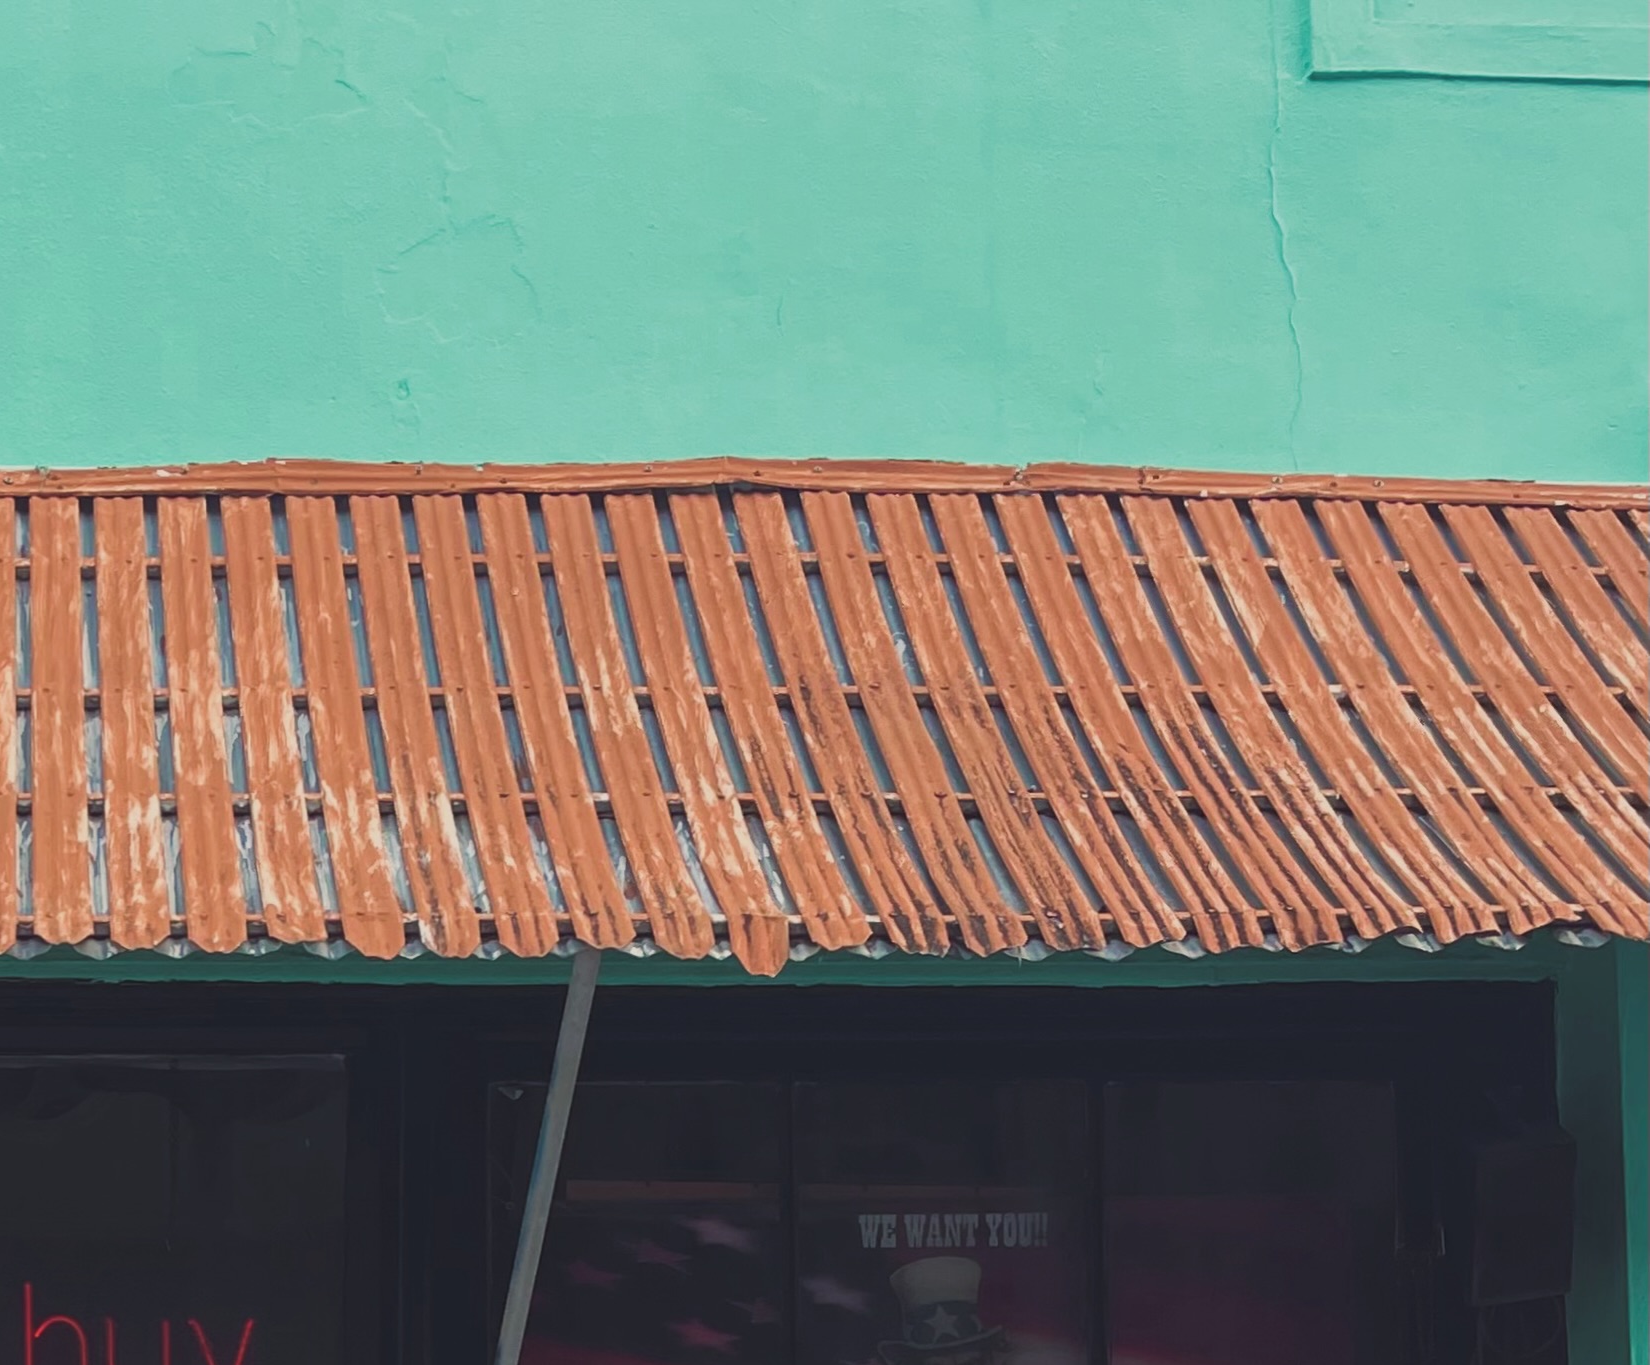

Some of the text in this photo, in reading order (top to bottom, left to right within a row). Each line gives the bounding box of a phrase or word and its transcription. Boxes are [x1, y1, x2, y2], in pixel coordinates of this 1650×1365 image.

[858, 1211, 1048, 1249] WE WANT YOU!!
